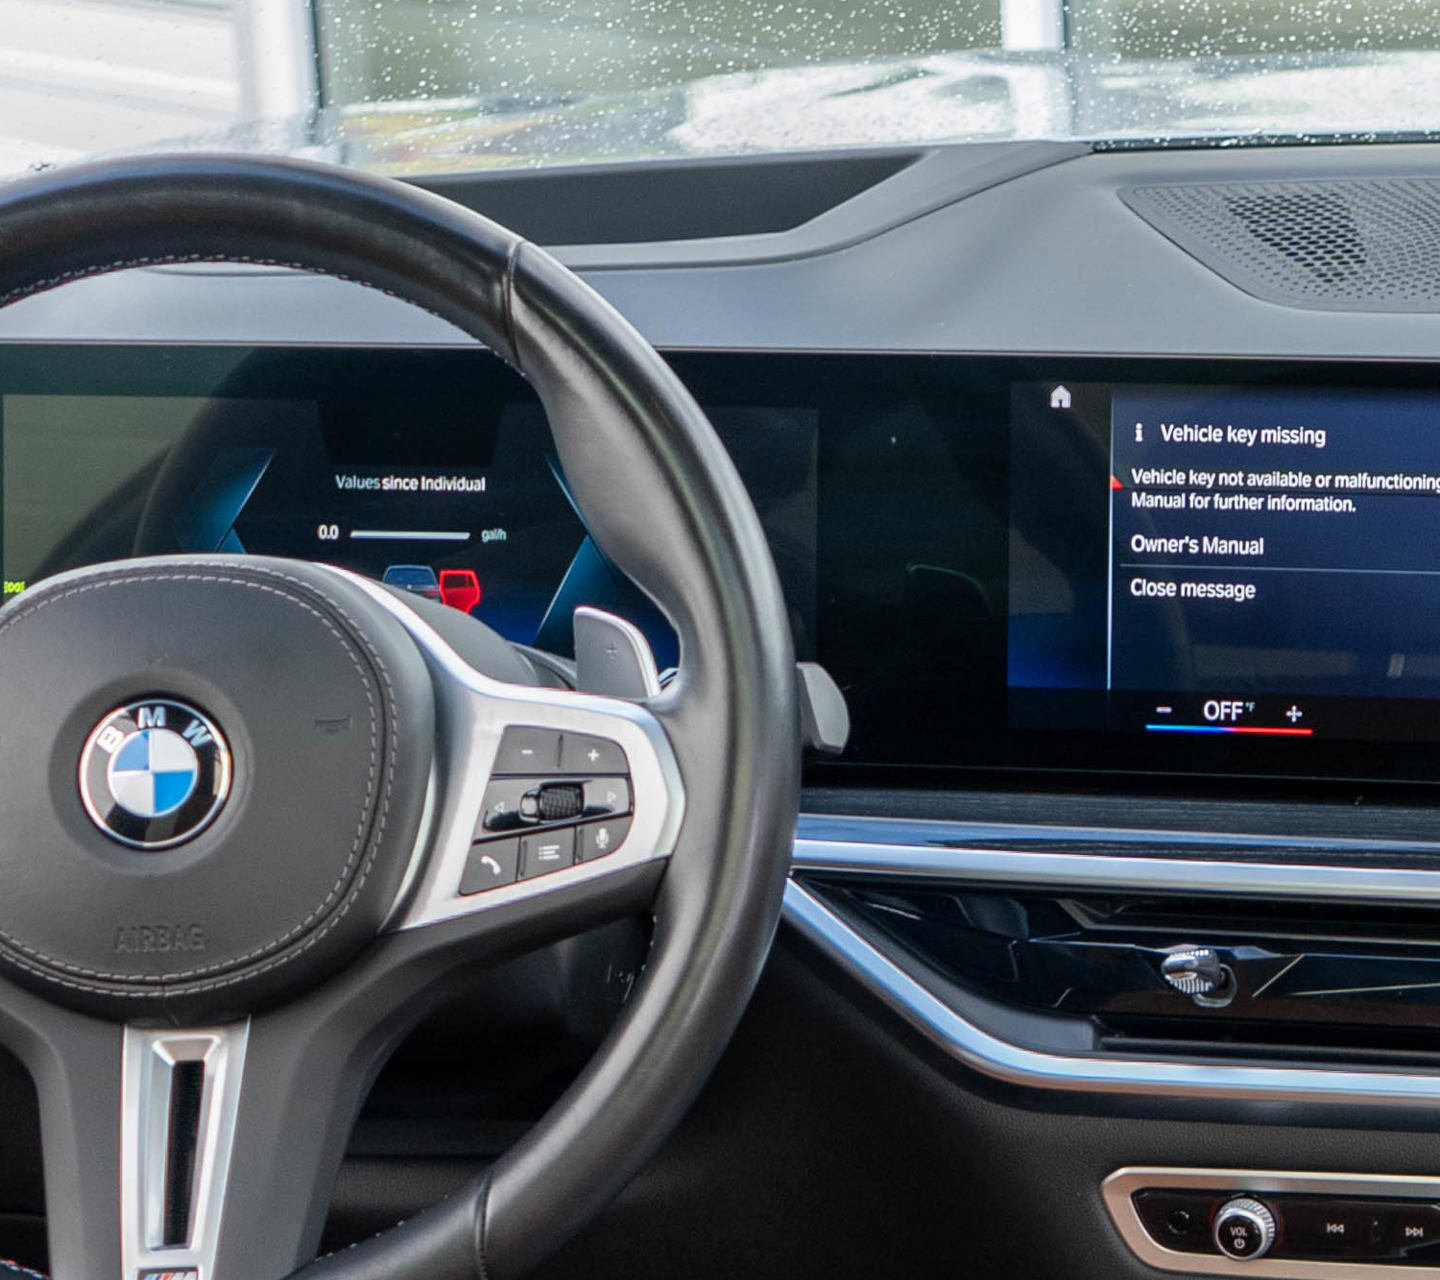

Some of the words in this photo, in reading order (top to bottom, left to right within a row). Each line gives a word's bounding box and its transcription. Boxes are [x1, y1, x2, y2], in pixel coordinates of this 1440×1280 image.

[1160, 423, 1224, 443] Vehicle
[1227, 424, 1257, 448] key
[1260, 426, 1327, 449] missing
[334, 474, 380, 491] Values
[382, 474, 419, 491] since
[420, 475, 486, 492] Individual
[1131, 468, 1186, 486] Vehicle
[1189, 470, 1216, 489] key
[1218, 472, 1245, 487] not
[1247, 471, 1312, 489] available
[1315, 476, 1332, 489] or
[1131, 491, 1186, 509] Manual
[1189, 492, 1211, 508] for
[1213, 492, 1265, 510] further
[1267, 493, 1357, 513] information.
[317, 524, 340, 541] 0.0
[1130, 535, 1200, 554] Owner's
[1203, 537, 1264, 556] Manual
[1130, 579, 1177, 597] Close
[1180, 582, 1257, 603] message
[1203, 700, 1243, 722] OFF
[96, 705, 213, 754] BMW
[1229, 1226, 1248, 1237] VOL
